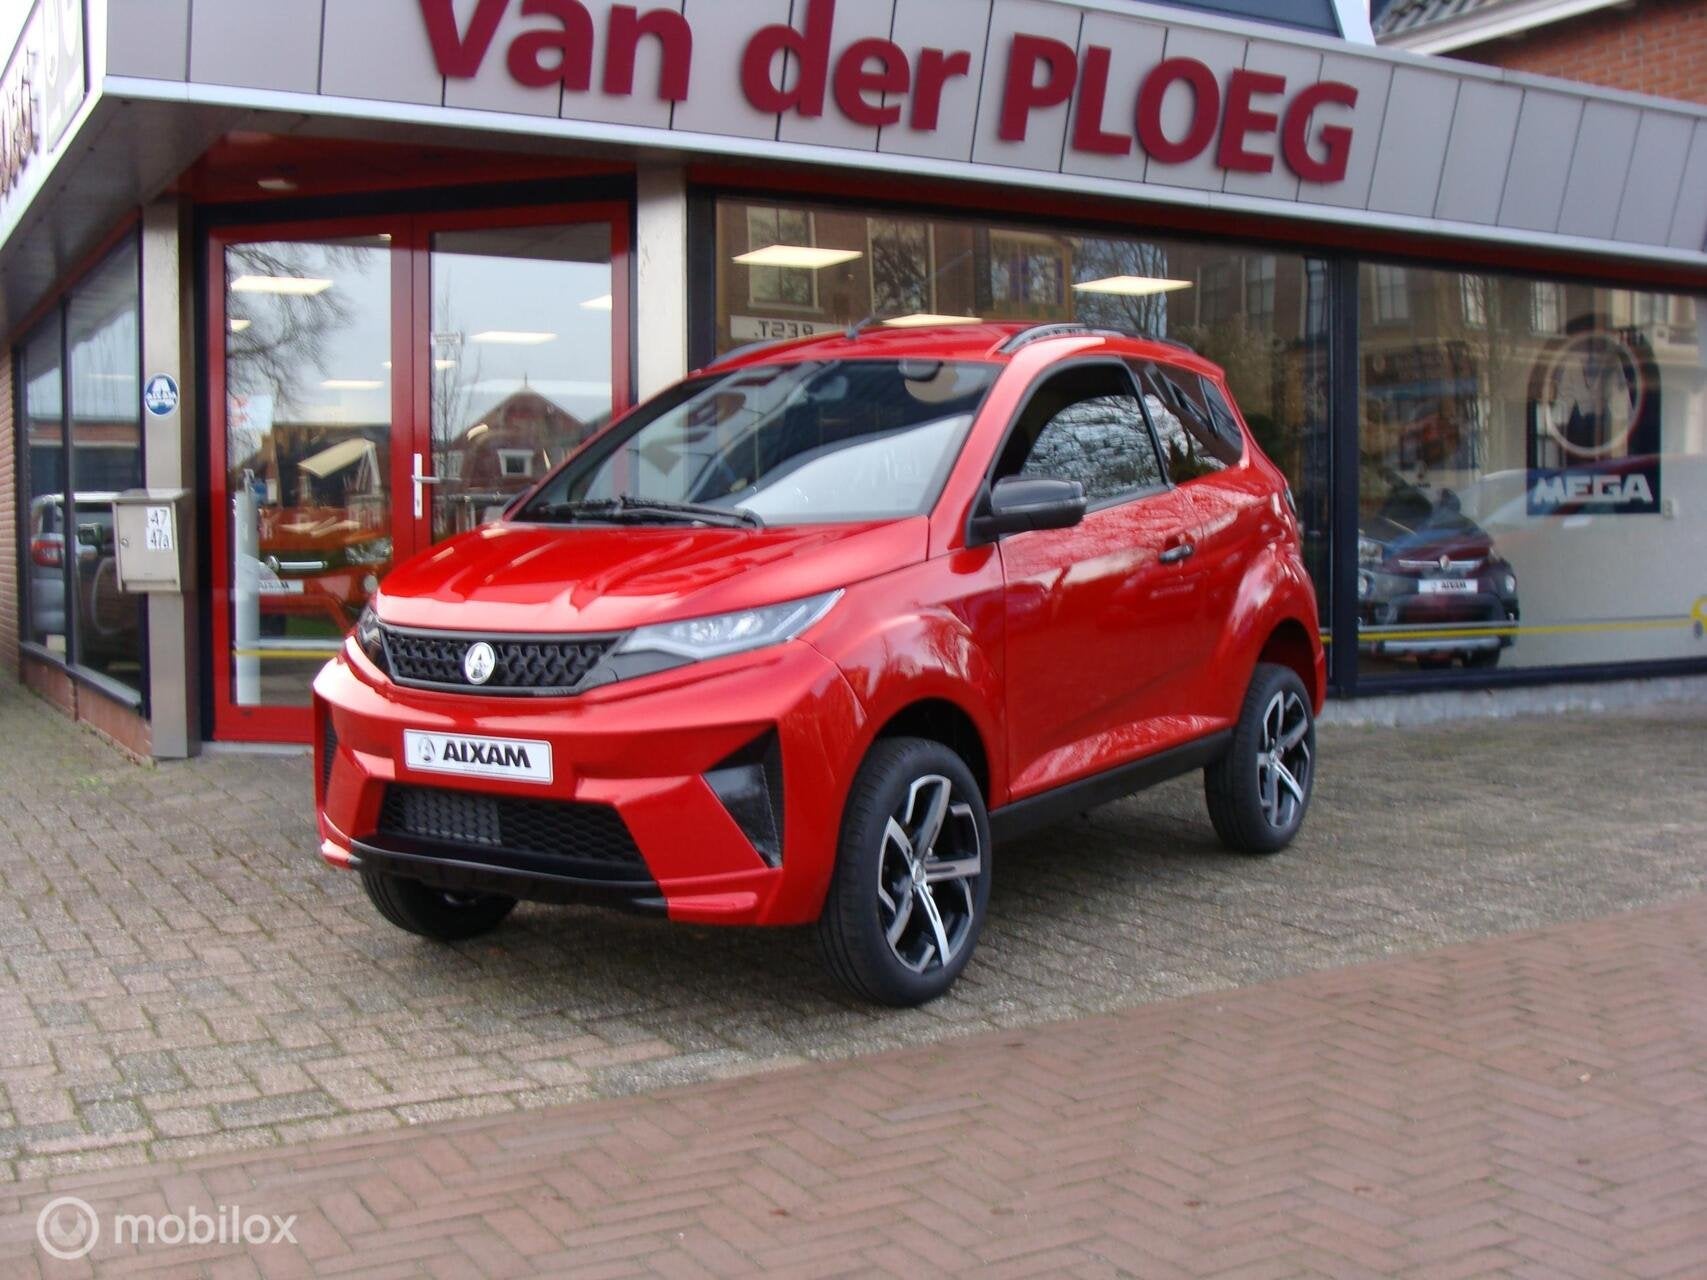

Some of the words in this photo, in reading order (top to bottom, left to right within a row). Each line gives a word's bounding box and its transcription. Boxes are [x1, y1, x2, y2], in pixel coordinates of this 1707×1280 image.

[417, 0, 693, 102] Van
[741, 0, 971, 131] der
[998, 33, 1359, 183] PLOEG
[1532, 474, 1653, 504] MEGA
[443, 739, 532, 768] AIXAM
